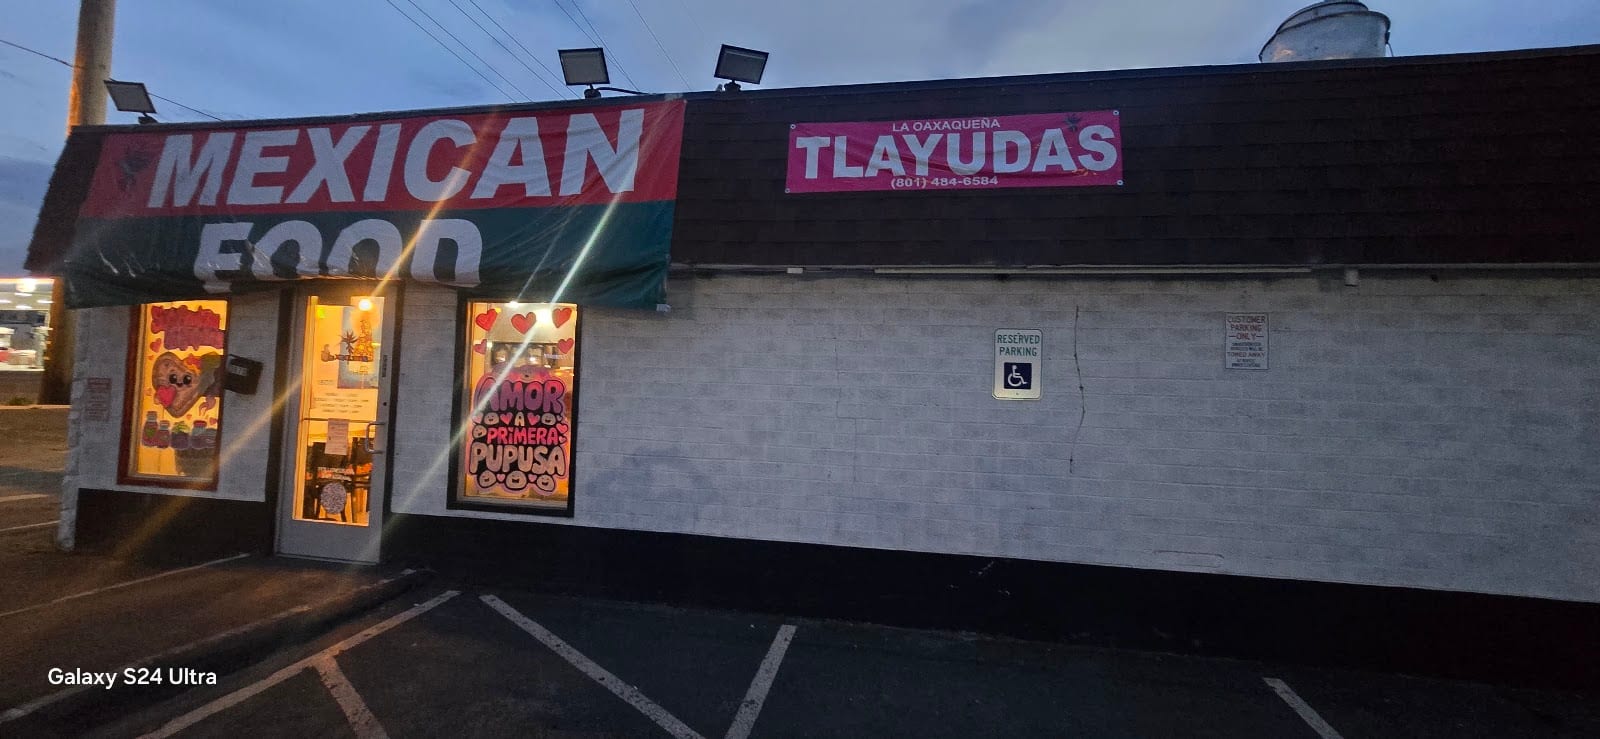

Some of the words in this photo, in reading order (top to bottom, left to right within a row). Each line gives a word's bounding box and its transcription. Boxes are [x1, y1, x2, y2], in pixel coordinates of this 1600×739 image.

[892, 122, 909, 132] LA
[913, 118, 1000, 131] OAXAQUEÑA
[146, 108, 646, 209] MEXICAN
[796, 125, 1118, 179] TLAYUDAS
[891, 178, 927, 189] (801)
[931, 176, 998, 186] 484-6584
[194, 218, 483, 293] FOOD
[1228, 315, 1266, 323] CUSTOMER
[1231, 324, 1262, 332] PARKING
[997, 334, 1040, 344] RESERVED
[1000, 347, 1037, 356] PARKING
[478, 377, 564, 414] AMOR
[514, 412, 525, 426] A
[469, 442, 565, 476] PUPUSA
